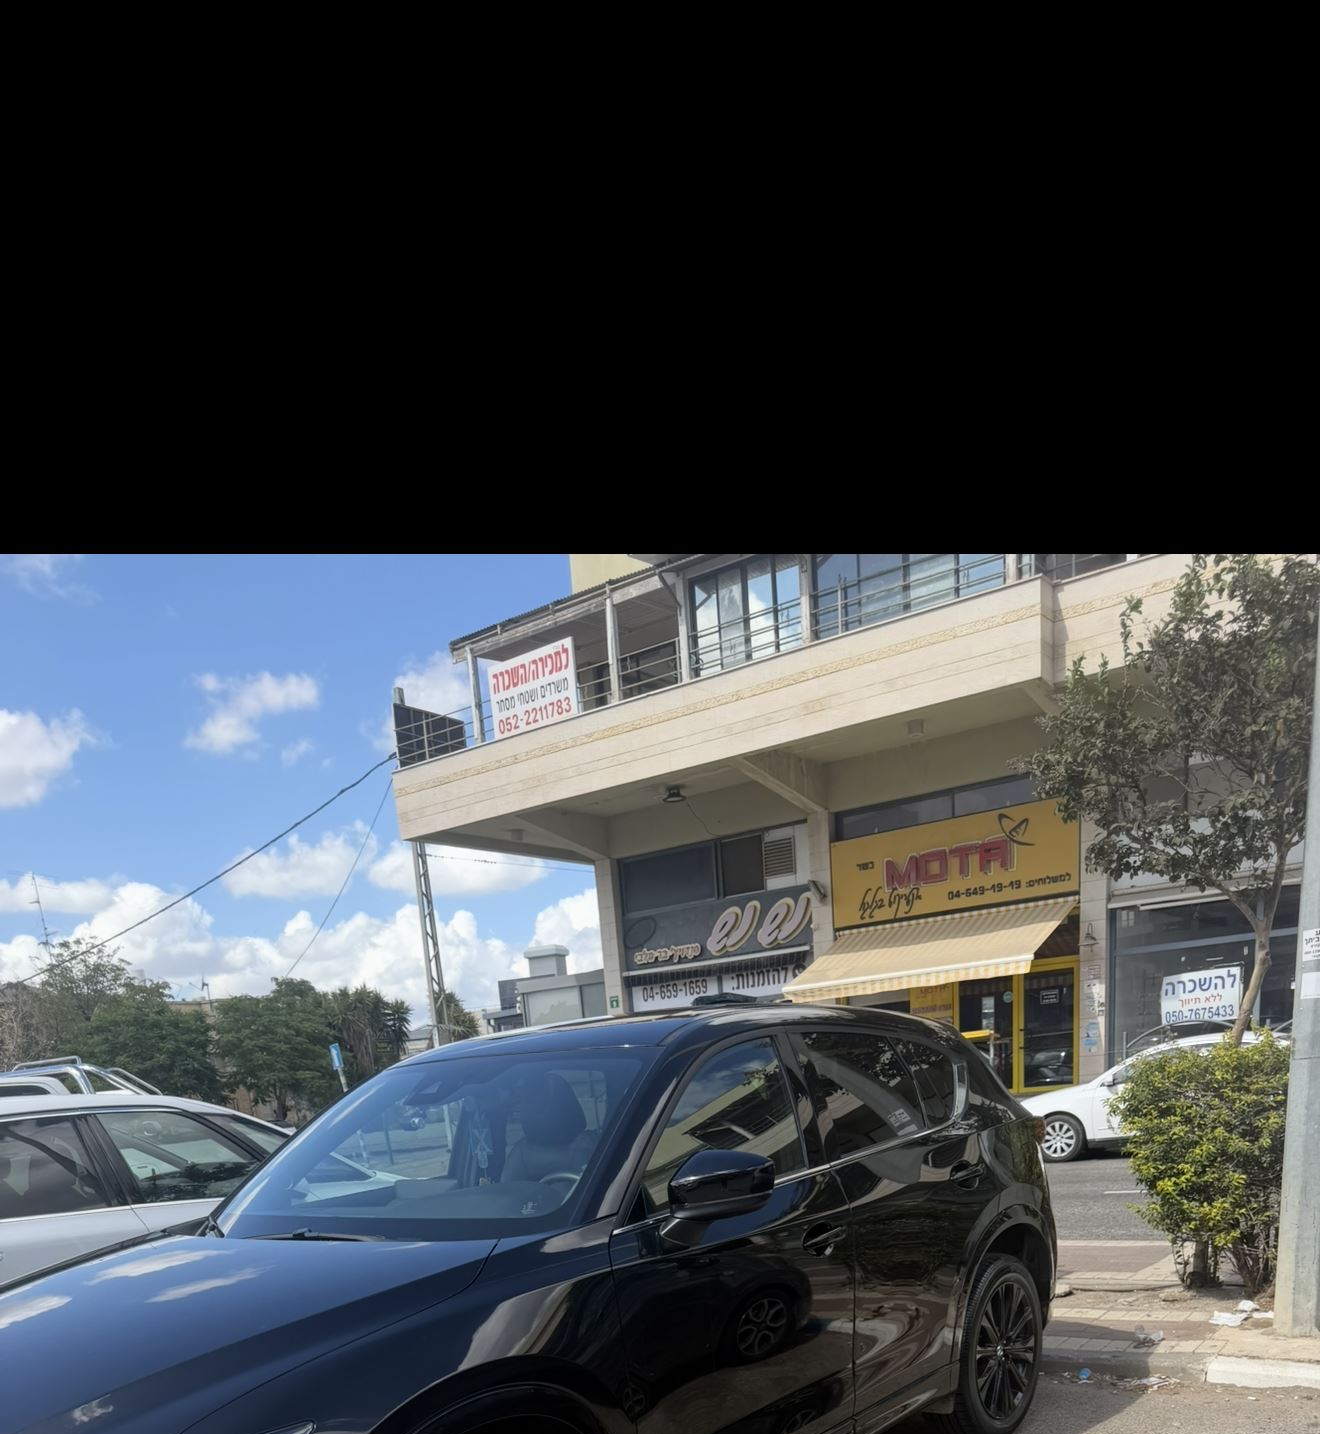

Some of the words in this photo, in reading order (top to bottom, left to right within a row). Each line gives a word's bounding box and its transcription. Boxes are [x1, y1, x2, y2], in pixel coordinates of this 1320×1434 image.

[492, 644, 569, 695] למכירה/השכרה
[517, 687, 539, 706] ושטחי
[541, 677, 569, 698] משרדים
[496, 695, 516, 713] מסחר
[498, 696, 572, 734] 052-2211783
[856, 861, 874, 872] כשר
[884, 834, 1016, 892] MOTA
[947, 880, 1022, 901] 04-649-19-19
[1025, 872, 1072, 888] למשלוחים:
[731, 966, 789, 991] להזמנות:
[1165, 969, 1237, 996] להשכרה
[642, 978, 708, 1002] 04-659-1659
[1204, 993, 1222, 1004] ללא
[1178, 997, 1201, 1008] תיווך
[1165, 1004, 1235, 1023] 050-7675433
